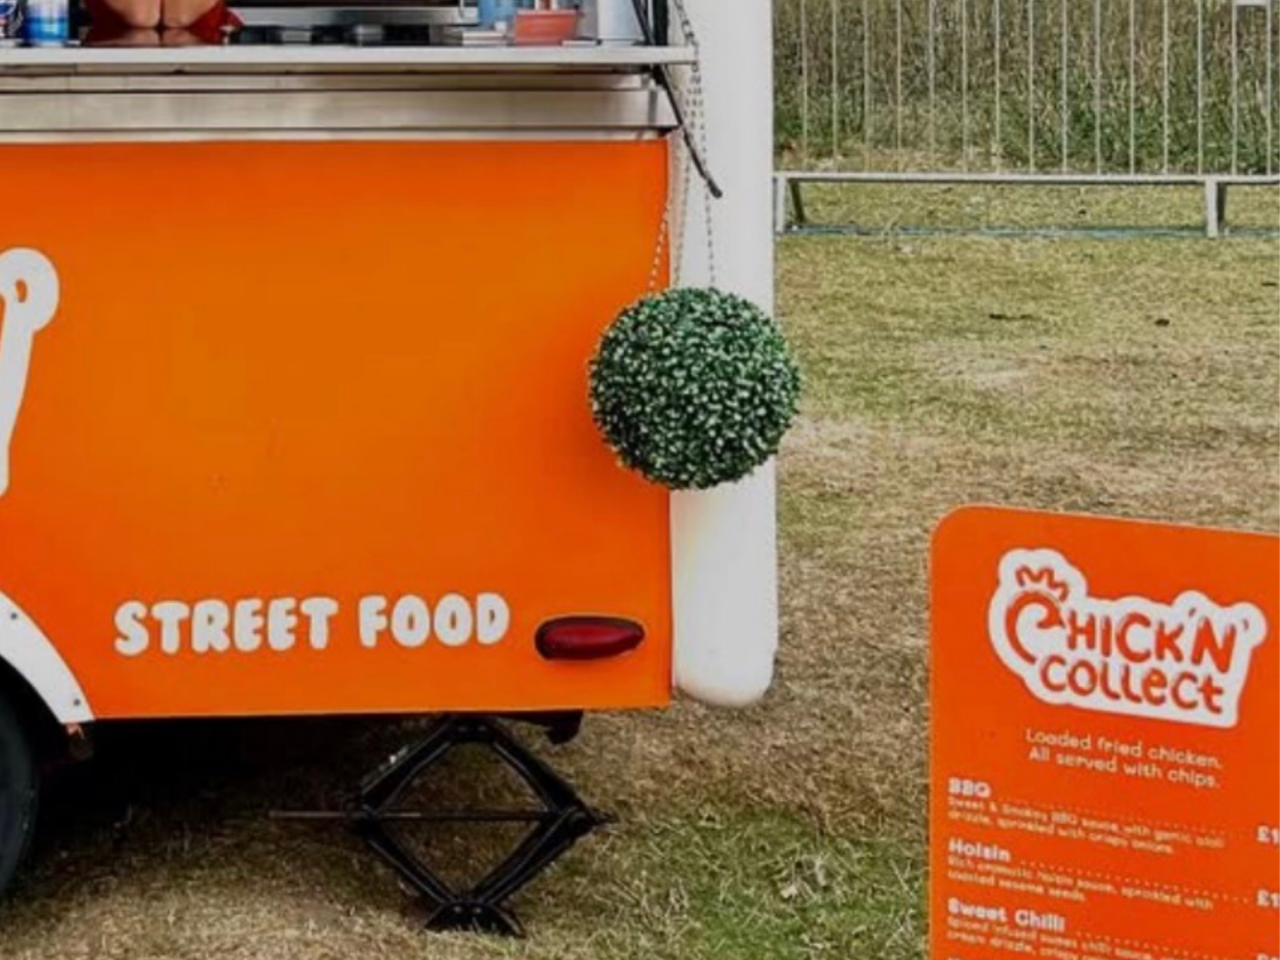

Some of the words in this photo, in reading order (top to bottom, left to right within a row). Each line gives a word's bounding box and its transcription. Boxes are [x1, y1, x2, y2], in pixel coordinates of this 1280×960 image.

[114, 597, 340, 657] STREET
[357, 592, 511, 648] FOOD
[1025, 728, 1092, 750] Loaded
[1097, 736, 1143, 758] fried
[1147, 744, 1223, 769] chicken.
[1029, 746, 1051, 762] All
[1056, 752, 1118, 773] served
[1123, 762, 1162, 780] with
[1166, 768, 1221, 789] chips.
[948, 776, 992, 798] BBQ
[948, 837, 1012, 863] Hoisin
[948, 896, 1008, 923] Sweet
[1014, 908, 1066, 933] Chilli
